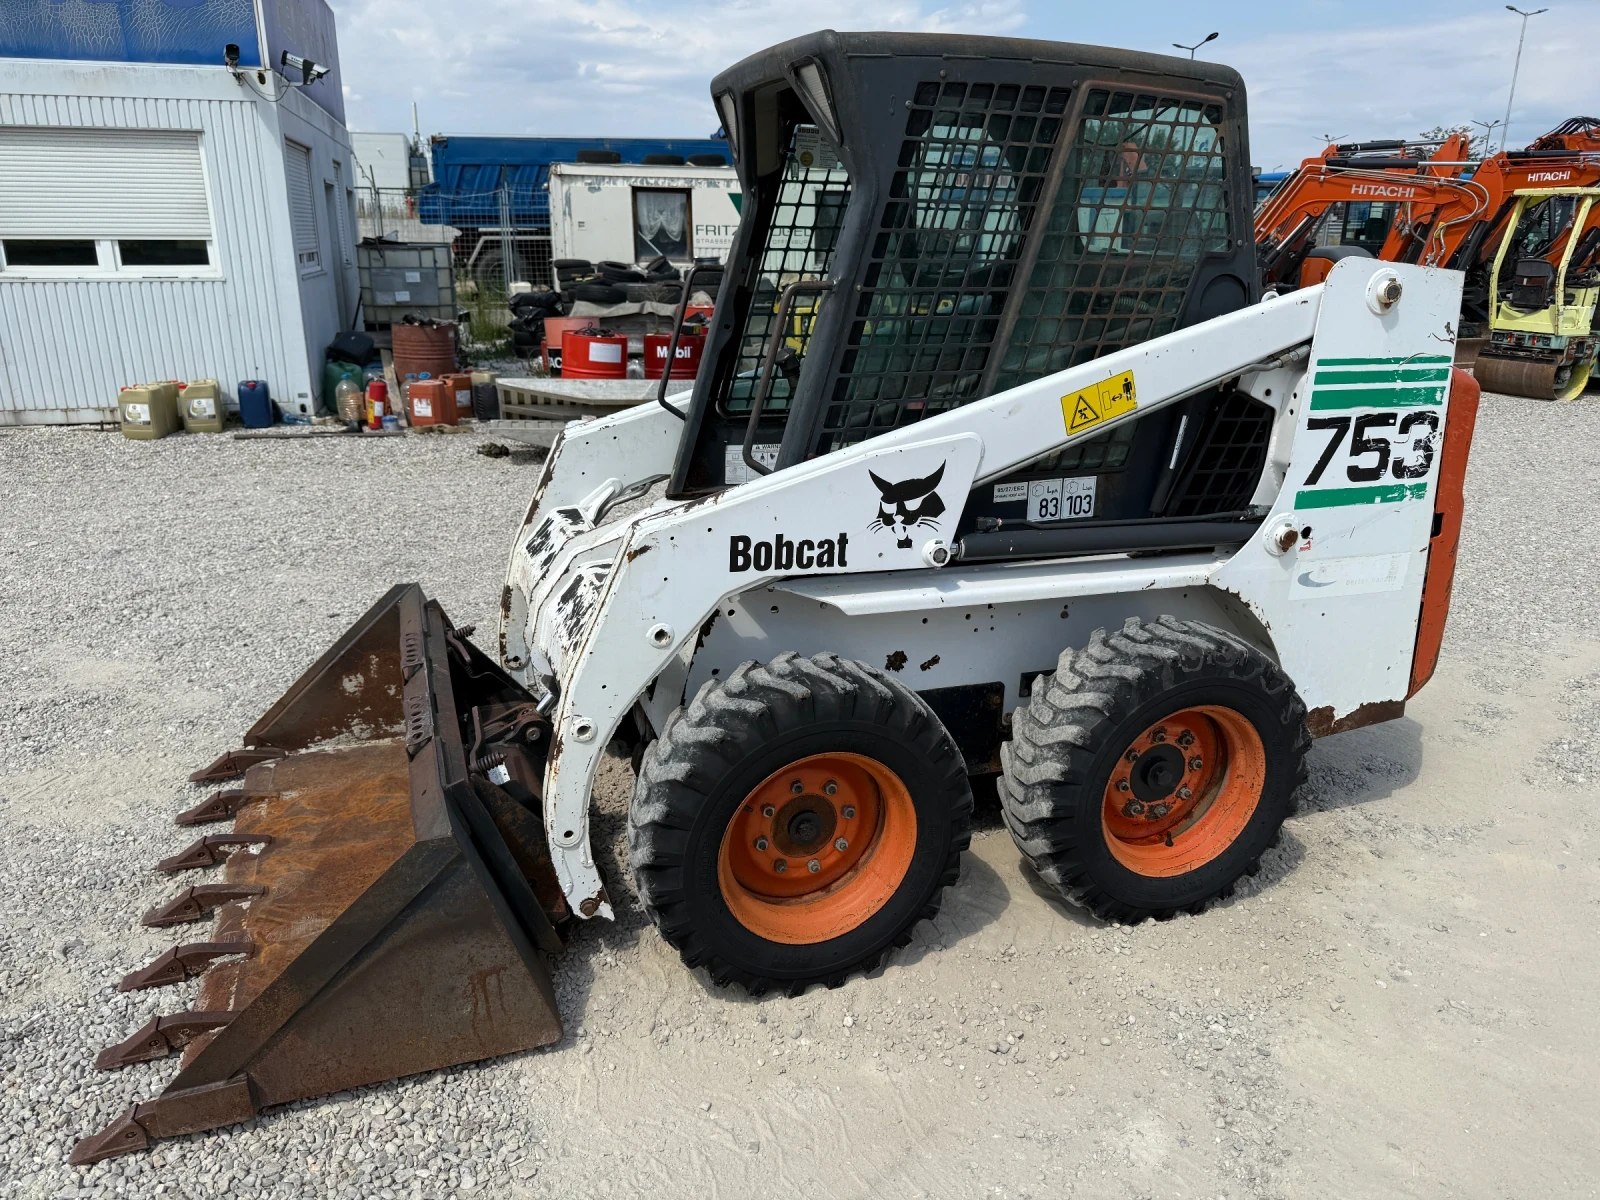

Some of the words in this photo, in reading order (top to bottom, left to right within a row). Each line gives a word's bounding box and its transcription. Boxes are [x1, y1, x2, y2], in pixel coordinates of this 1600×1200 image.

[1527, 170, 1571, 183] HITACHI
[1350, 184, 1415, 198] HITACHI
[657, 345, 691, 358] Mbil
[1302, 410, 1442, 486] 753
[1039, 497, 1059, 518] 83
[1066, 494, 1092, 515] 103
[729, 532, 849, 572] Bobcat
